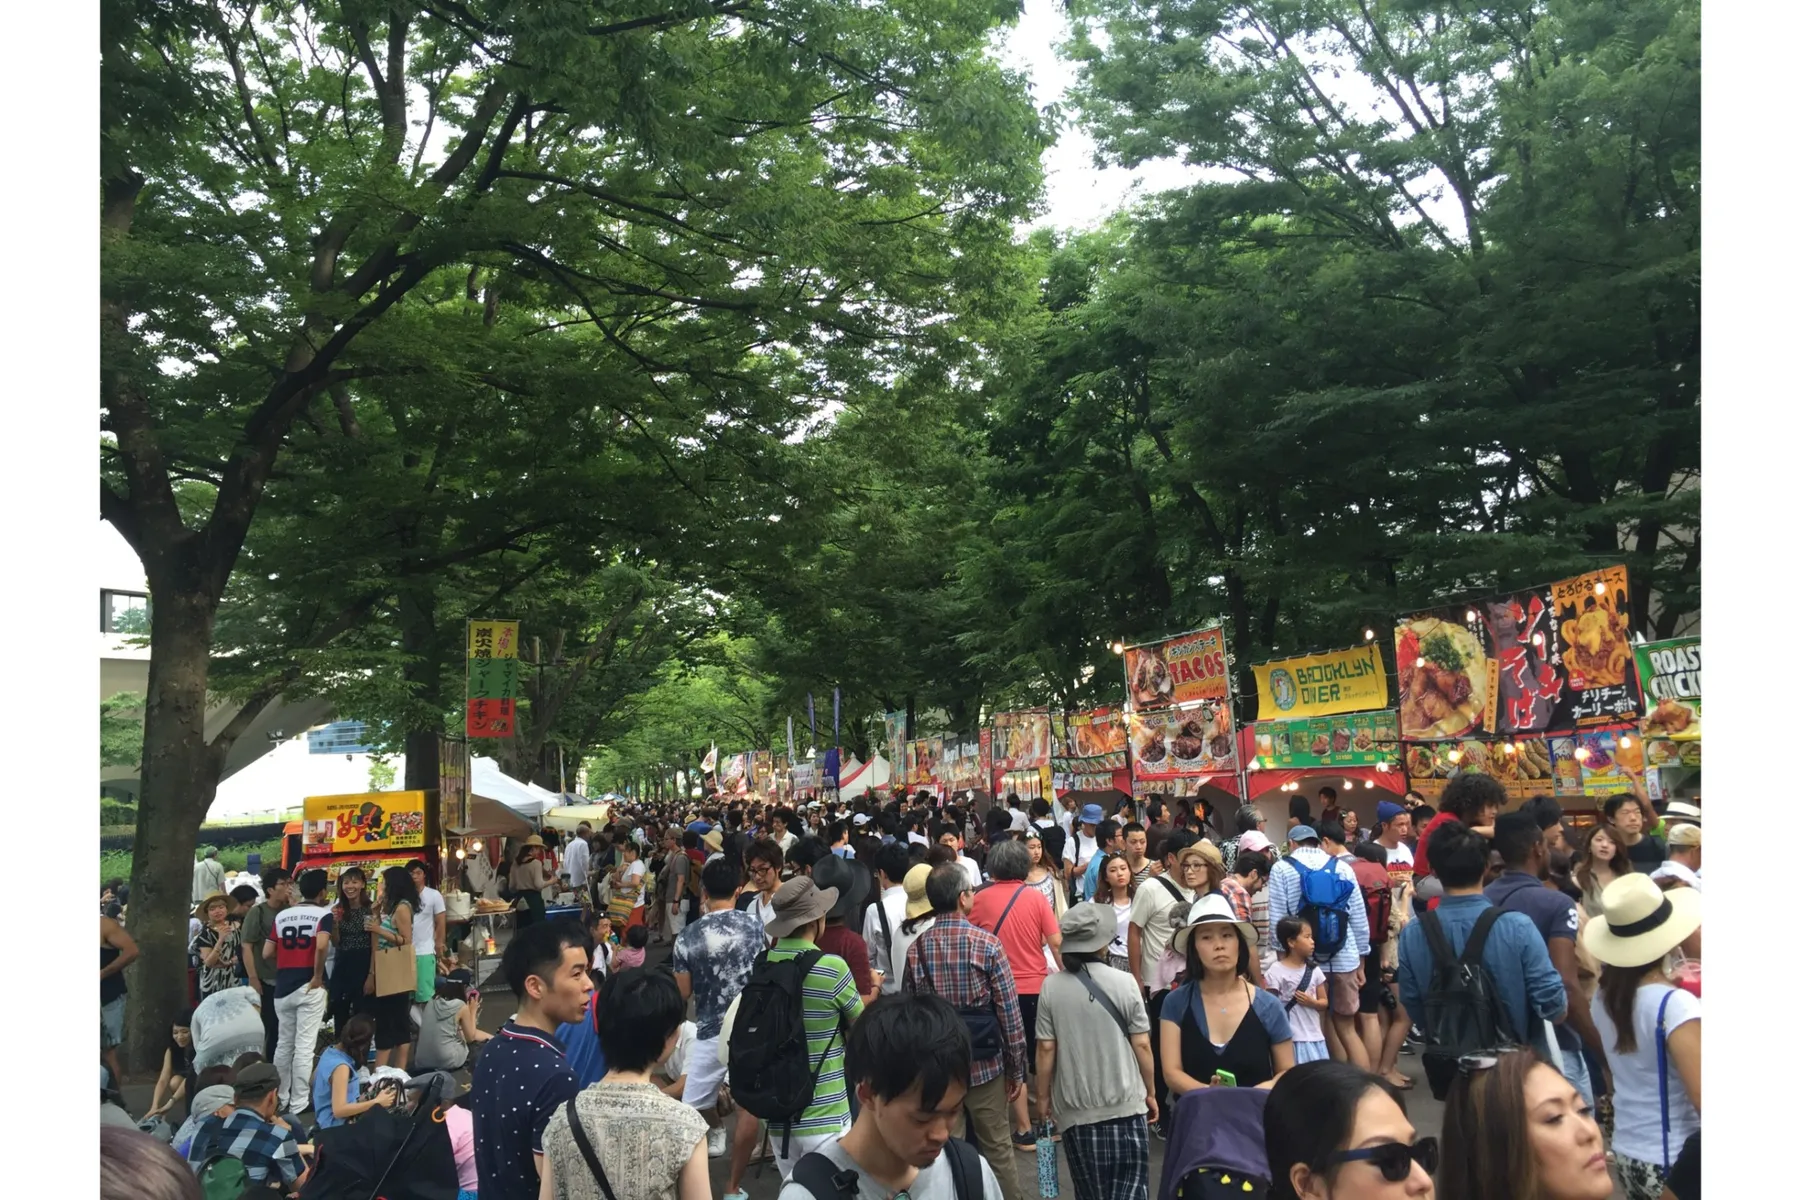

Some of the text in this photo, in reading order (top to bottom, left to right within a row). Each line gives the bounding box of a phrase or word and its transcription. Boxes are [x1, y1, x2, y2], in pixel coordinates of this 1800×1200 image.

[1168, 651, 1225, 685] TACOS
[1296, 657, 1376, 685] BROOKLYN
[278, 914, 319, 924] UNITED STATES
[1566, 908, 1579, 930] 3
[282, 924, 313, 950] 85
